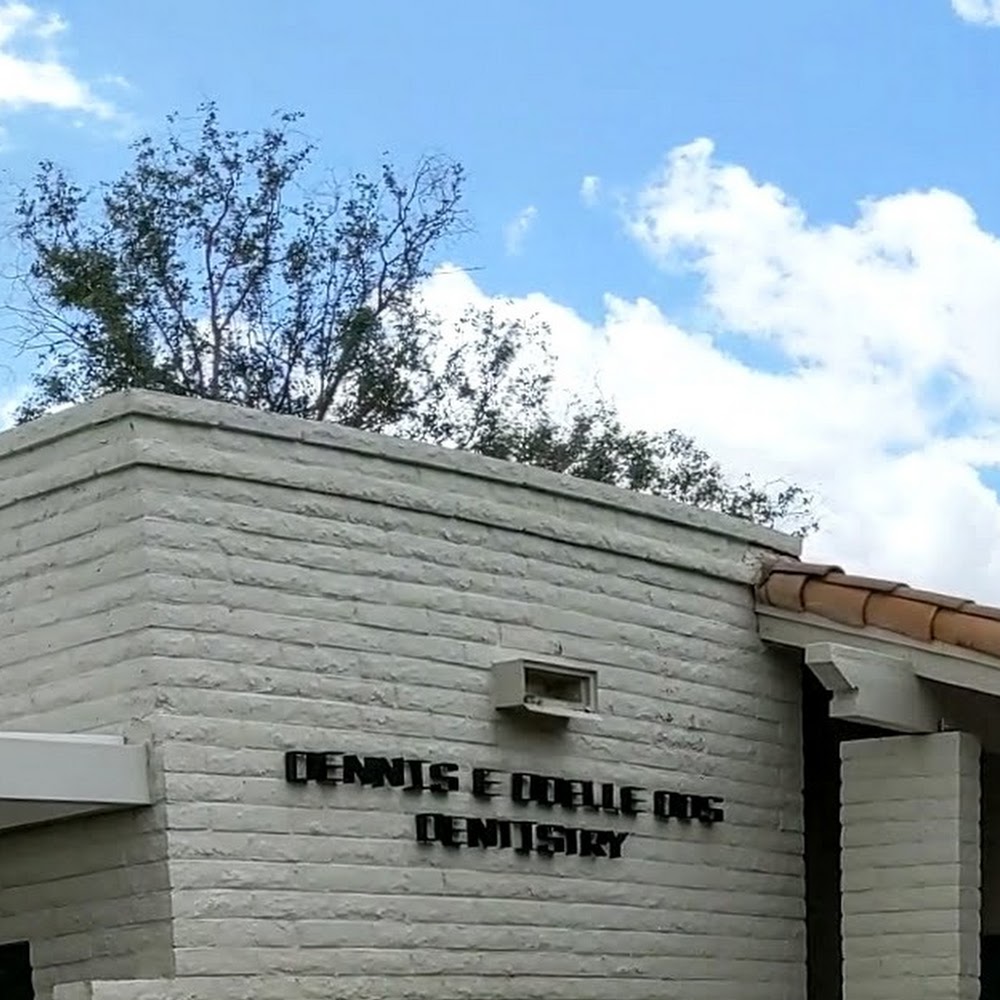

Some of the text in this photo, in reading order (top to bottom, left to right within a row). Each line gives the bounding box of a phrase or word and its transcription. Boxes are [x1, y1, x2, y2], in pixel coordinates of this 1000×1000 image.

[285, 751, 459, 791] DENNIS
[472, 768, 503, 796] E
[415, 813, 629, 859] DENTISTRY
